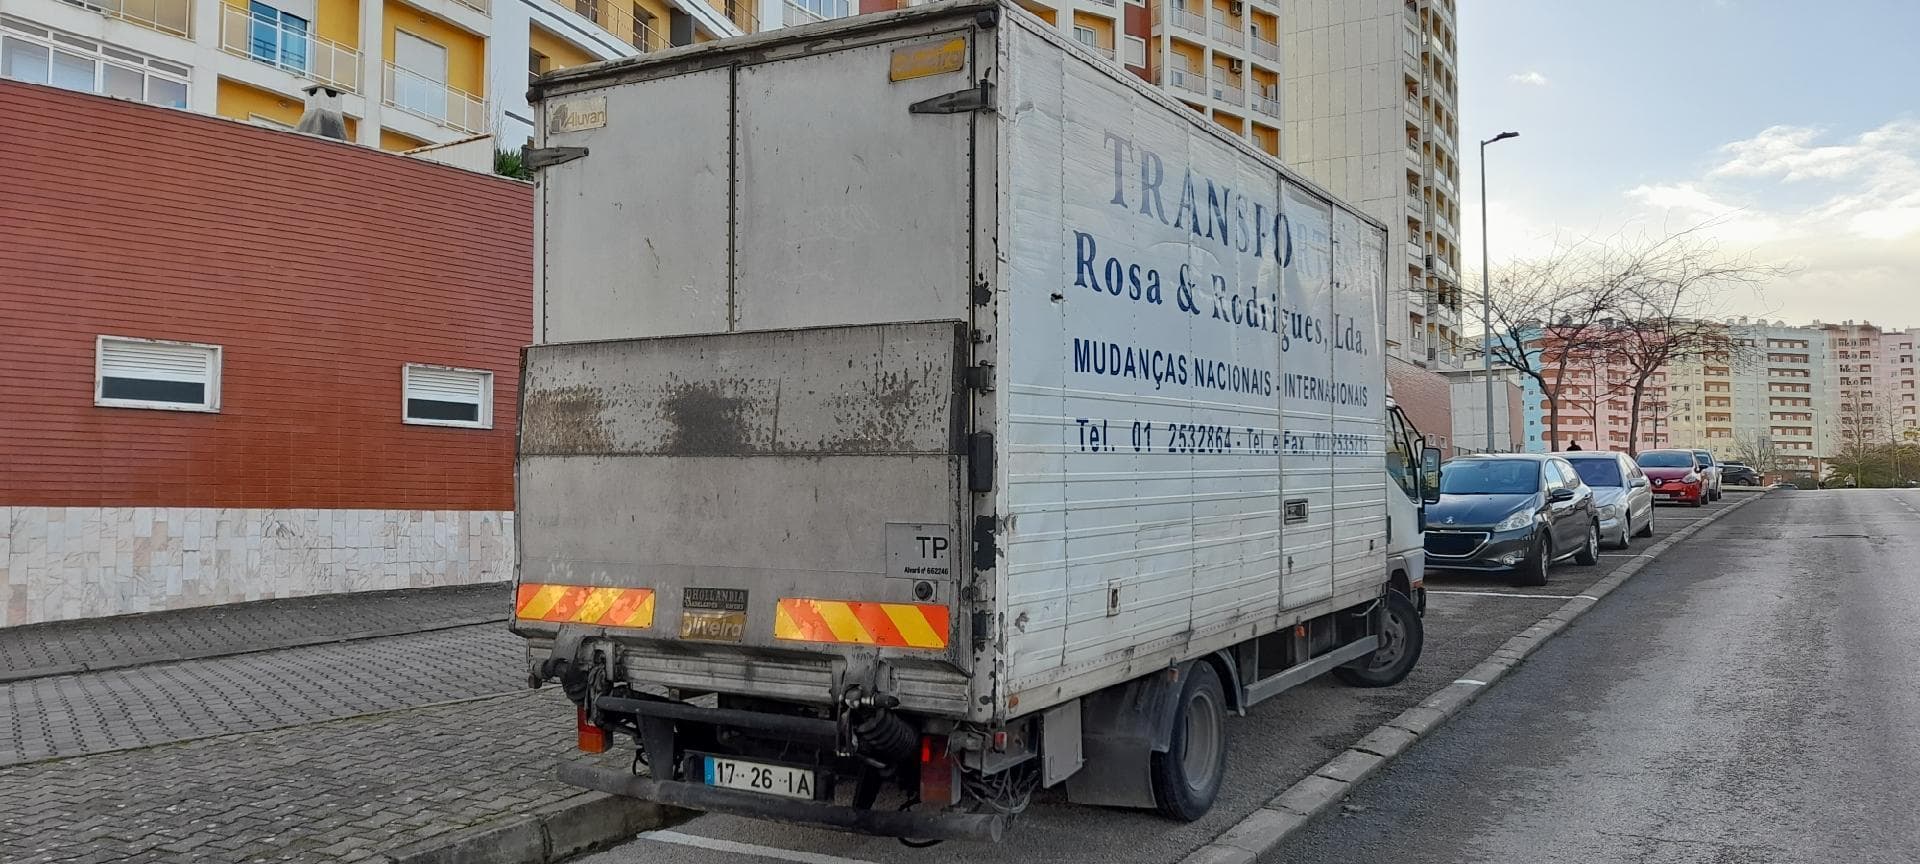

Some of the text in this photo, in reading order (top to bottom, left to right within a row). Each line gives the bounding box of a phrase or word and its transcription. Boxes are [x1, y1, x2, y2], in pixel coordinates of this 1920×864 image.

[564, 111, 605, 128] Aluvan
[1073, 230, 1368, 356] Rosa & Rodrigues, Lda.
[1074, 338, 1187, 390] MUDANÇAS
[1194, 357, 1271, 397] NACIONAIS
[1284, 372, 1368, 408] INTERNACIONAIS
[1076, 419, 1115, 452] Tel.
[1132, 422, 1151, 452] 01
[1168, 423, 1231, 453] 2532864
[1272, 435, 1279, 454] e
[927, 567, 949, 575] 662246
